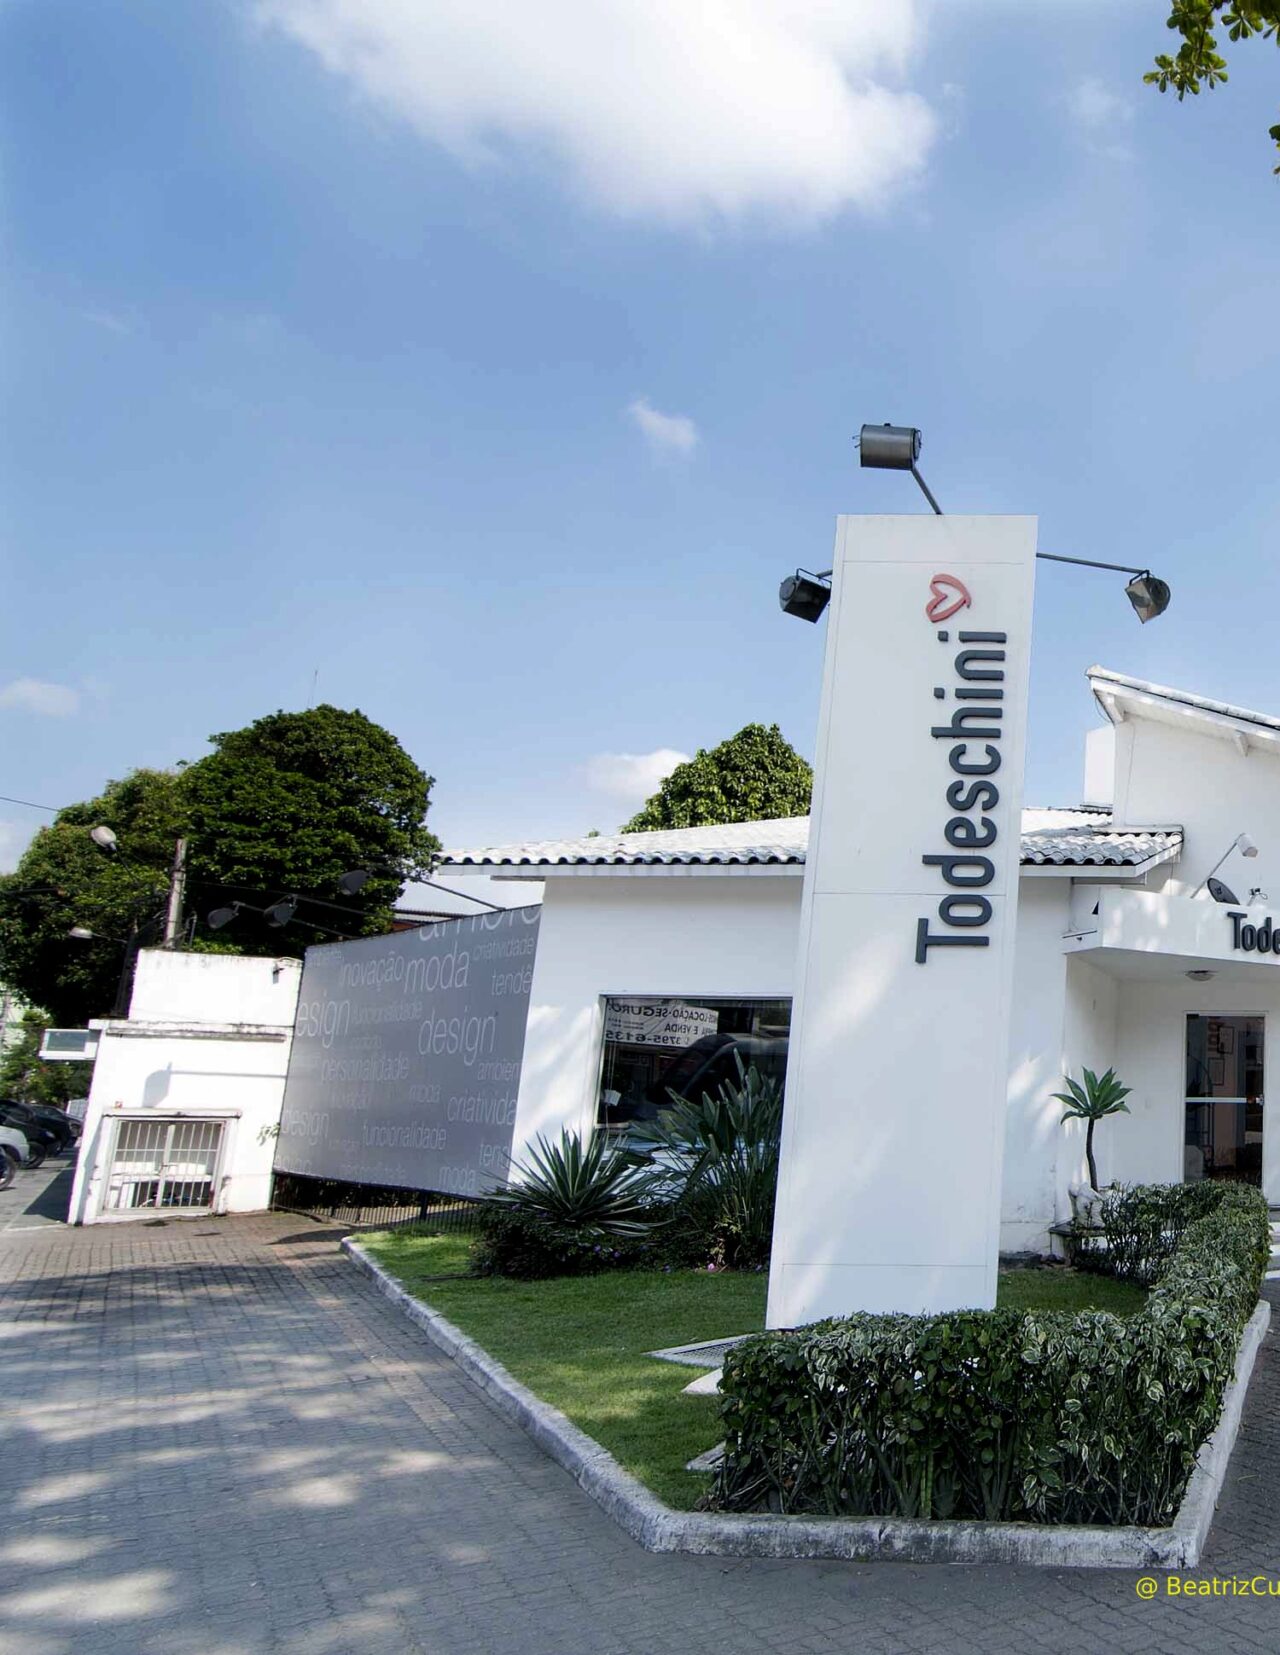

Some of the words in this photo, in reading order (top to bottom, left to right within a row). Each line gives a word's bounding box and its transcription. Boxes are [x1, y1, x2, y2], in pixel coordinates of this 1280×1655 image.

[915, 631, 1007, 964] Todeschini
[404, 941, 470, 994] moda
[418, 1007, 496, 1066] design
